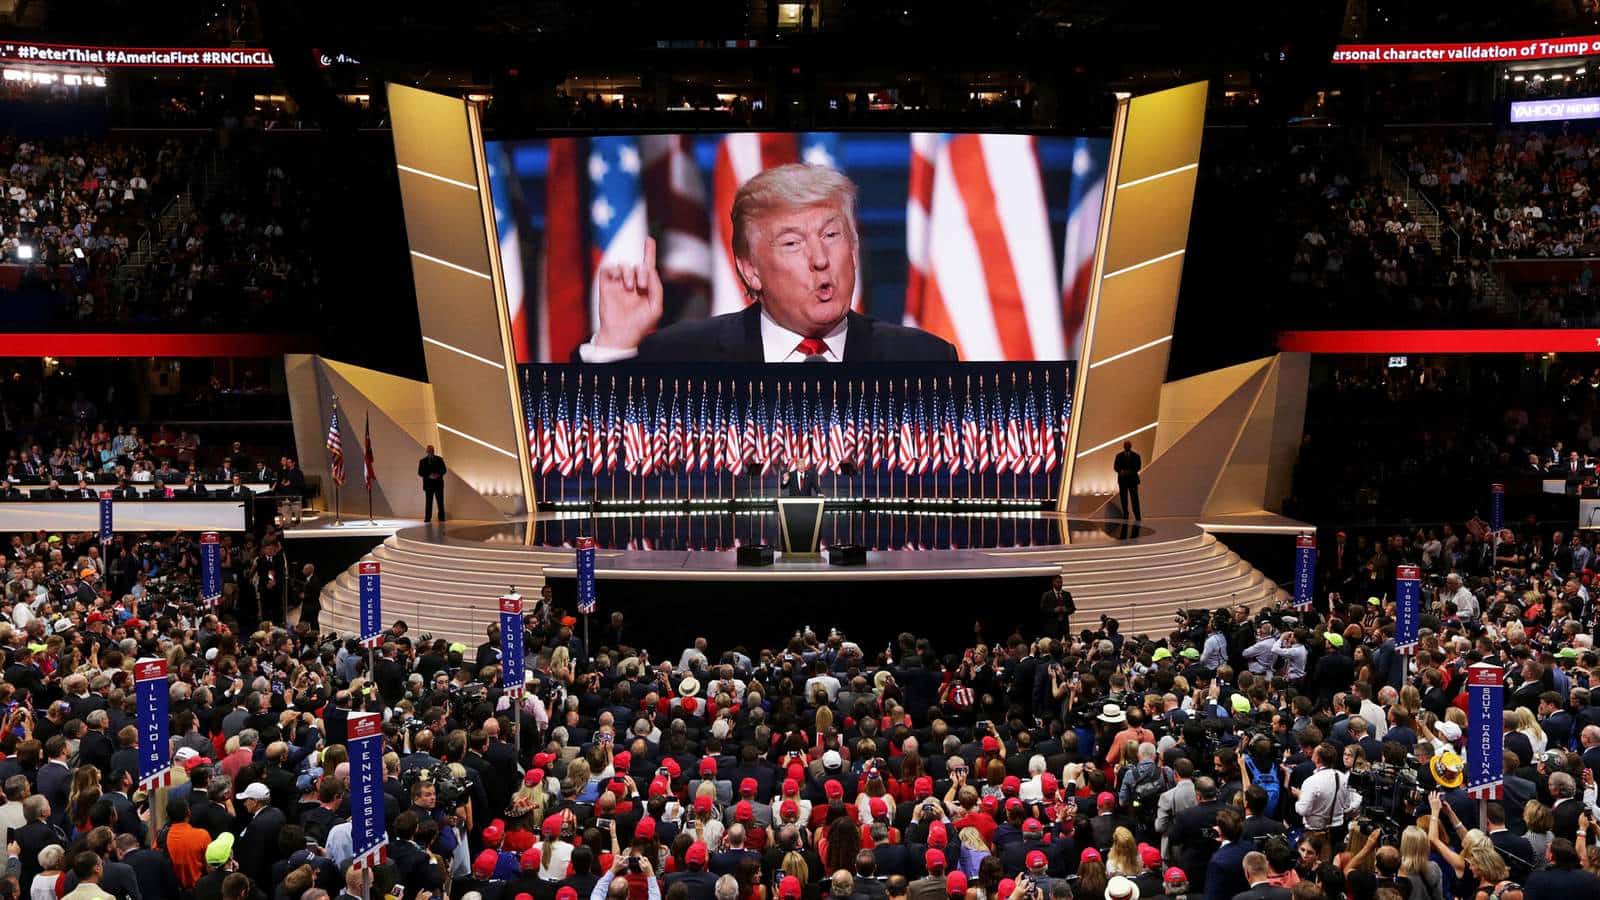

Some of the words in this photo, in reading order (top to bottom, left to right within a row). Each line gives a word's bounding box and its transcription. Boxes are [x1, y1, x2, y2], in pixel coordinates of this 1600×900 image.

[18, 46, 103, 62] #PeterThiel
[106, 50, 199, 64] #AmericaFirst
[1383, 47, 1445, 60] character
[1448, 46, 1517, 58] validation
[1520, 43, 1537, 55] of
[1540, 41, 1588, 54] Trump
[366, 575, 374, 592] NEW
[1301, 548, 1309, 598] CALIFORNIA
[1403, 581, 1412, 638] WISCONSIN
[506, 616, 515, 676] FLORIDA
[148, 683, 159, 761] ILLINOIS
[1481, 687, 1491, 719] SOUTH
[1481, 724, 1491, 775] CAROLINA
[360, 740, 374, 838] TENNESSEE
